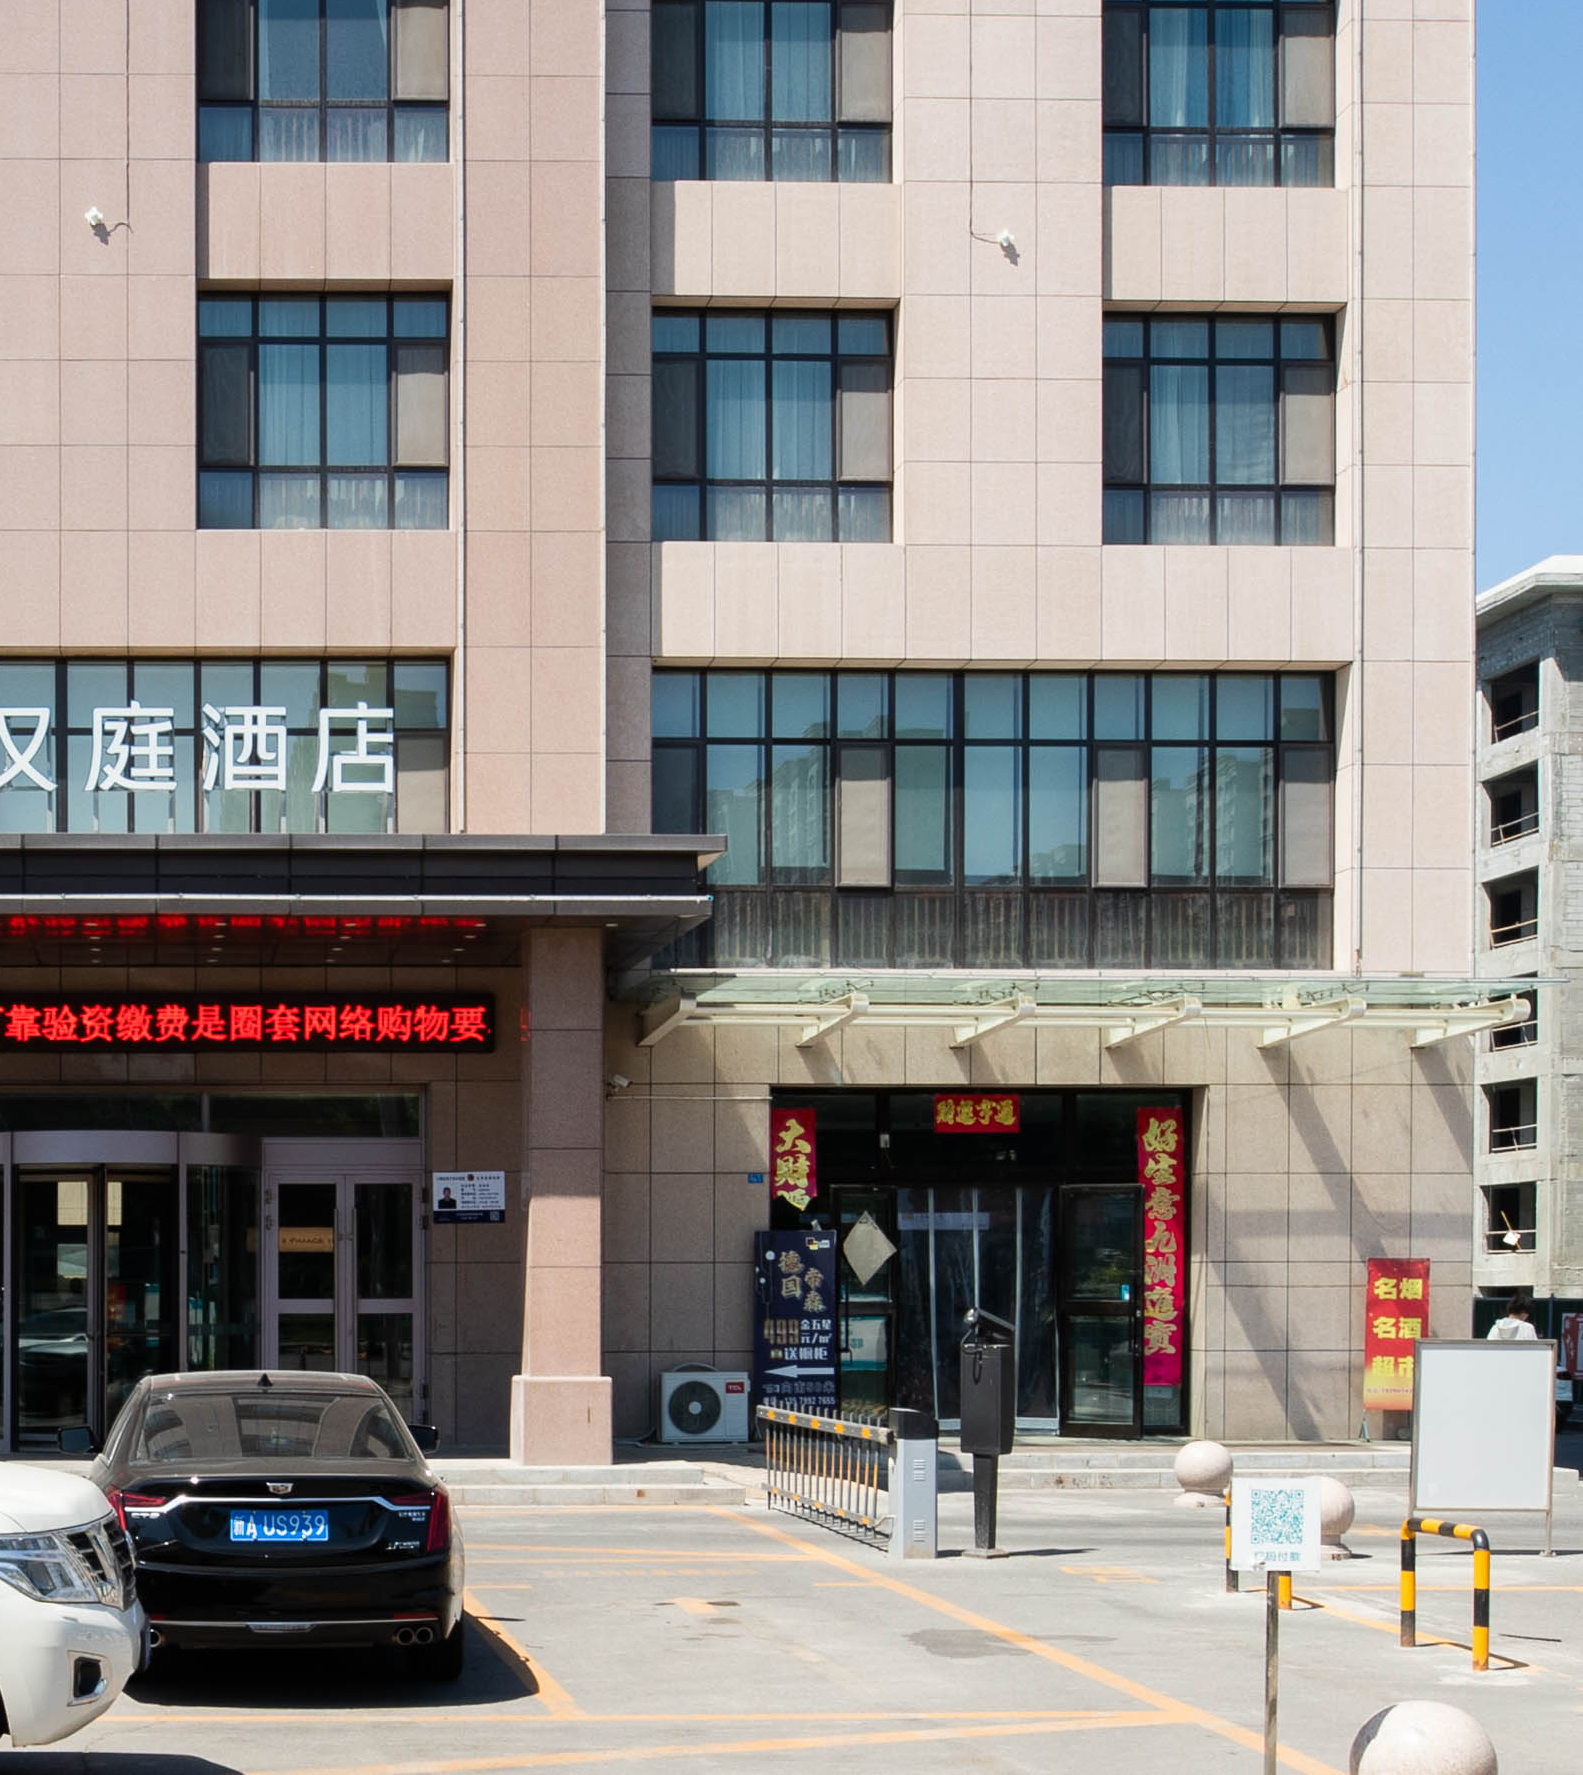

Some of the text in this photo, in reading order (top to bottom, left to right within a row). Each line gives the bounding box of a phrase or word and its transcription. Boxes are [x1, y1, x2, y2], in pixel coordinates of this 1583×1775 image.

[1373, 1277, 1423, 1300] 名烟
[1372, 1316, 1422, 1340] 名酒
[1371, 1355, 1414, 1378] 超市
